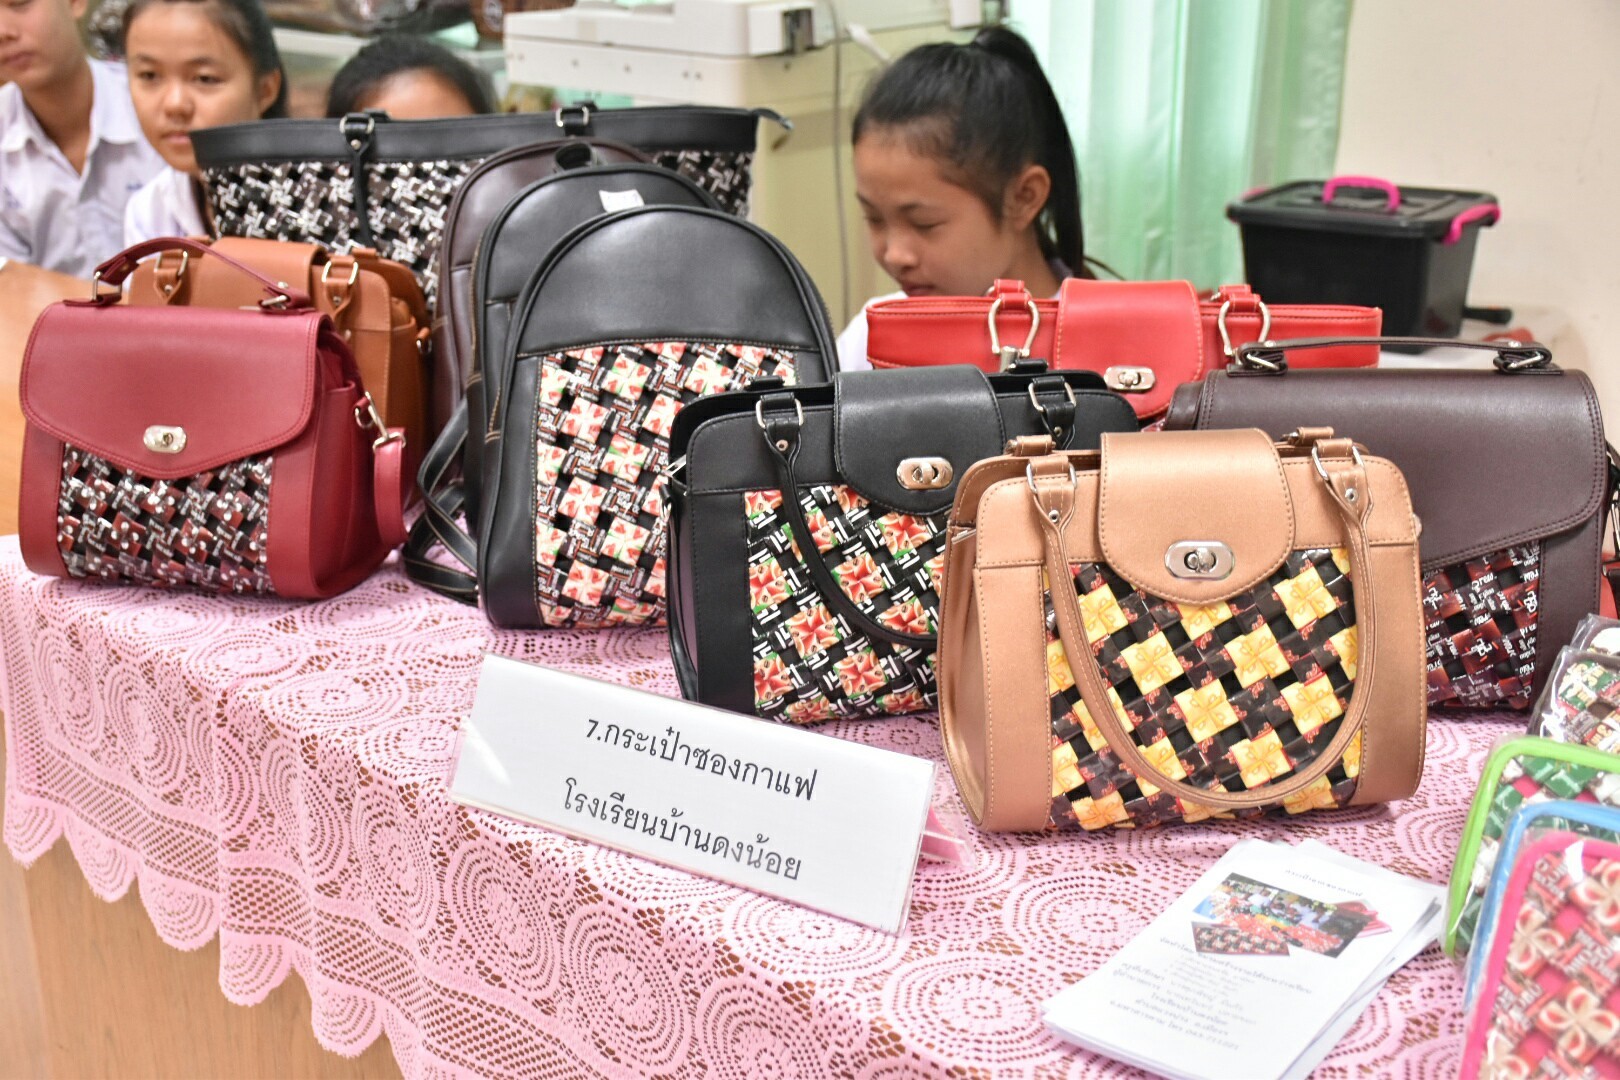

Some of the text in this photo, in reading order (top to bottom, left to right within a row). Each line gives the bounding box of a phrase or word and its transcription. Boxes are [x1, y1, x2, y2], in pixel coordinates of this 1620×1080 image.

[586, 719, 818, 800] 7.กระเป๋าซองกาแฟ
[564, 777, 802, 880] โรงเรียนบ้านดงน้อย
